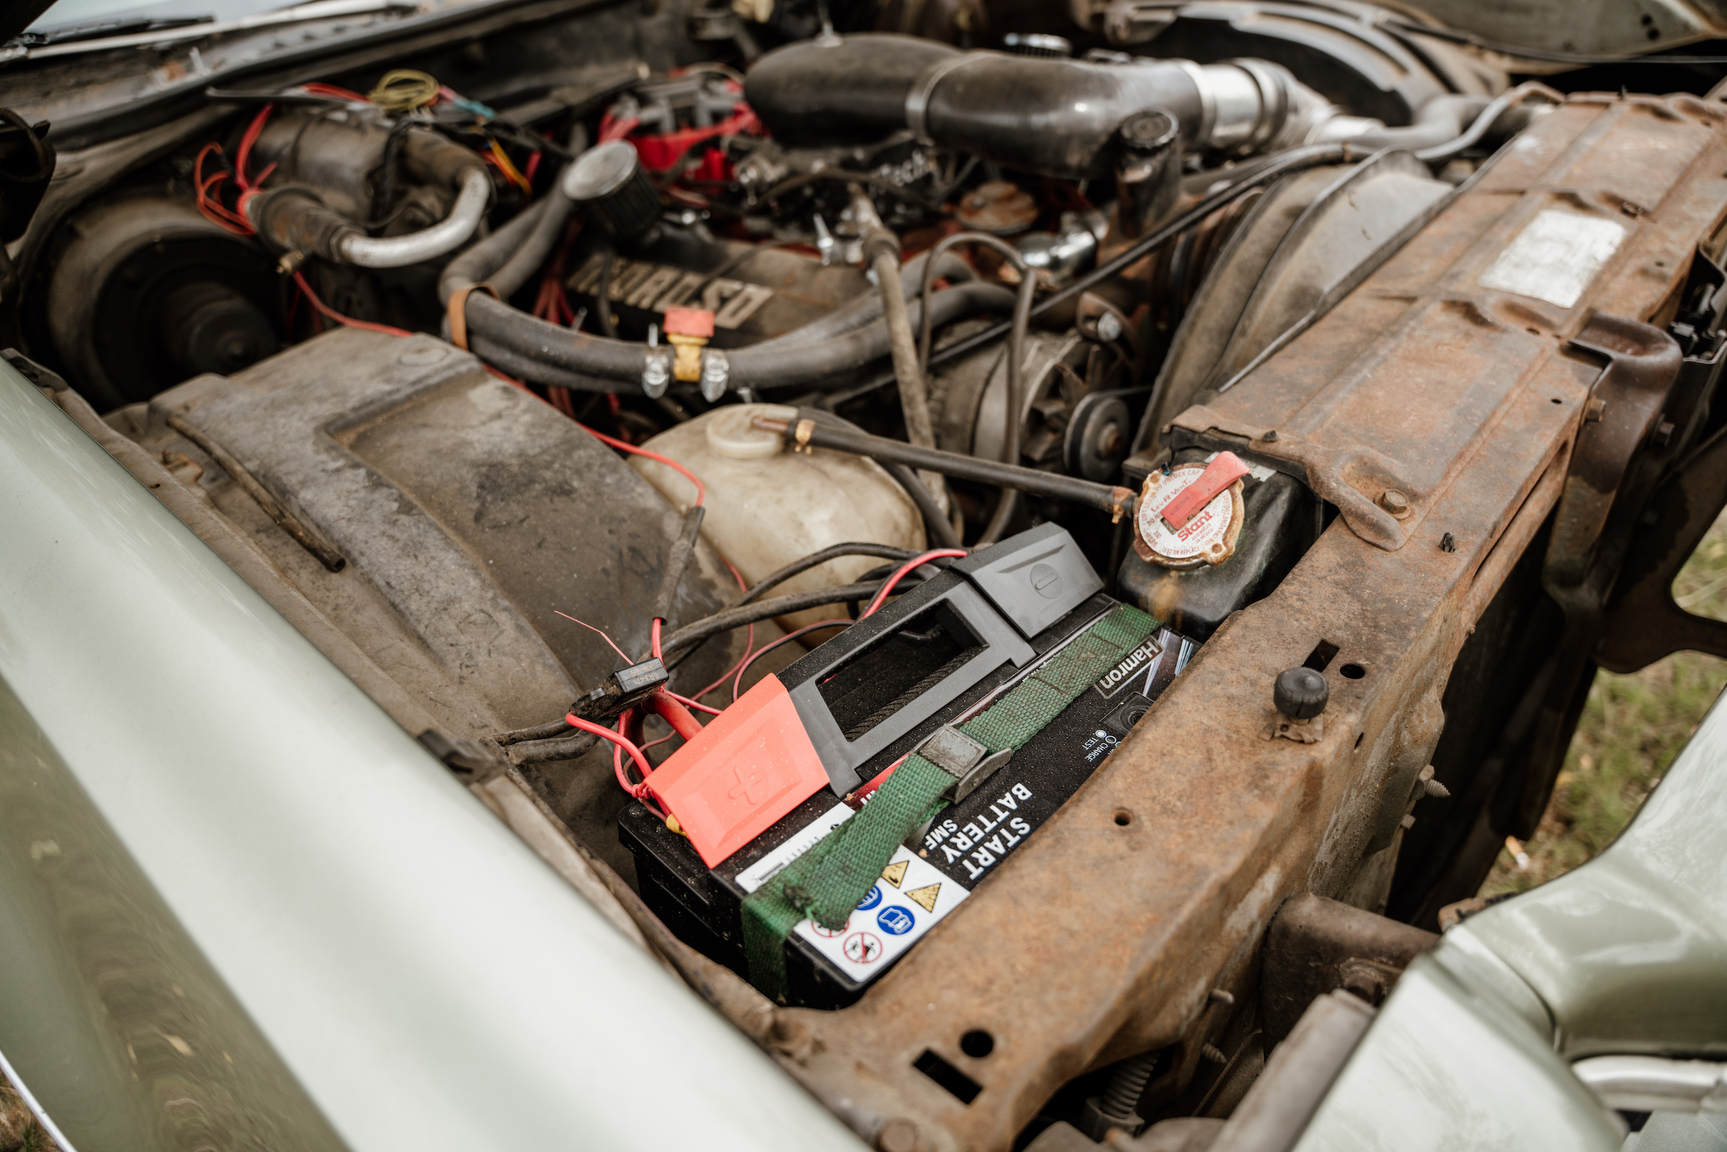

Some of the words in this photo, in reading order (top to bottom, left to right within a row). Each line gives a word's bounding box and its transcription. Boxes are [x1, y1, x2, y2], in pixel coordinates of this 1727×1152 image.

[1177, 511, 1213, 542] Stant
[1099, 641, 1159, 689] Hamron
[1082, 737, 1099, 750] TEST
[1085, 742, 1108, 762] CHARGE
[924, 819, 958, 851] SMF
[941, 782, 1033, 864] BATTERY
[962, 817, 1031, 880] START
